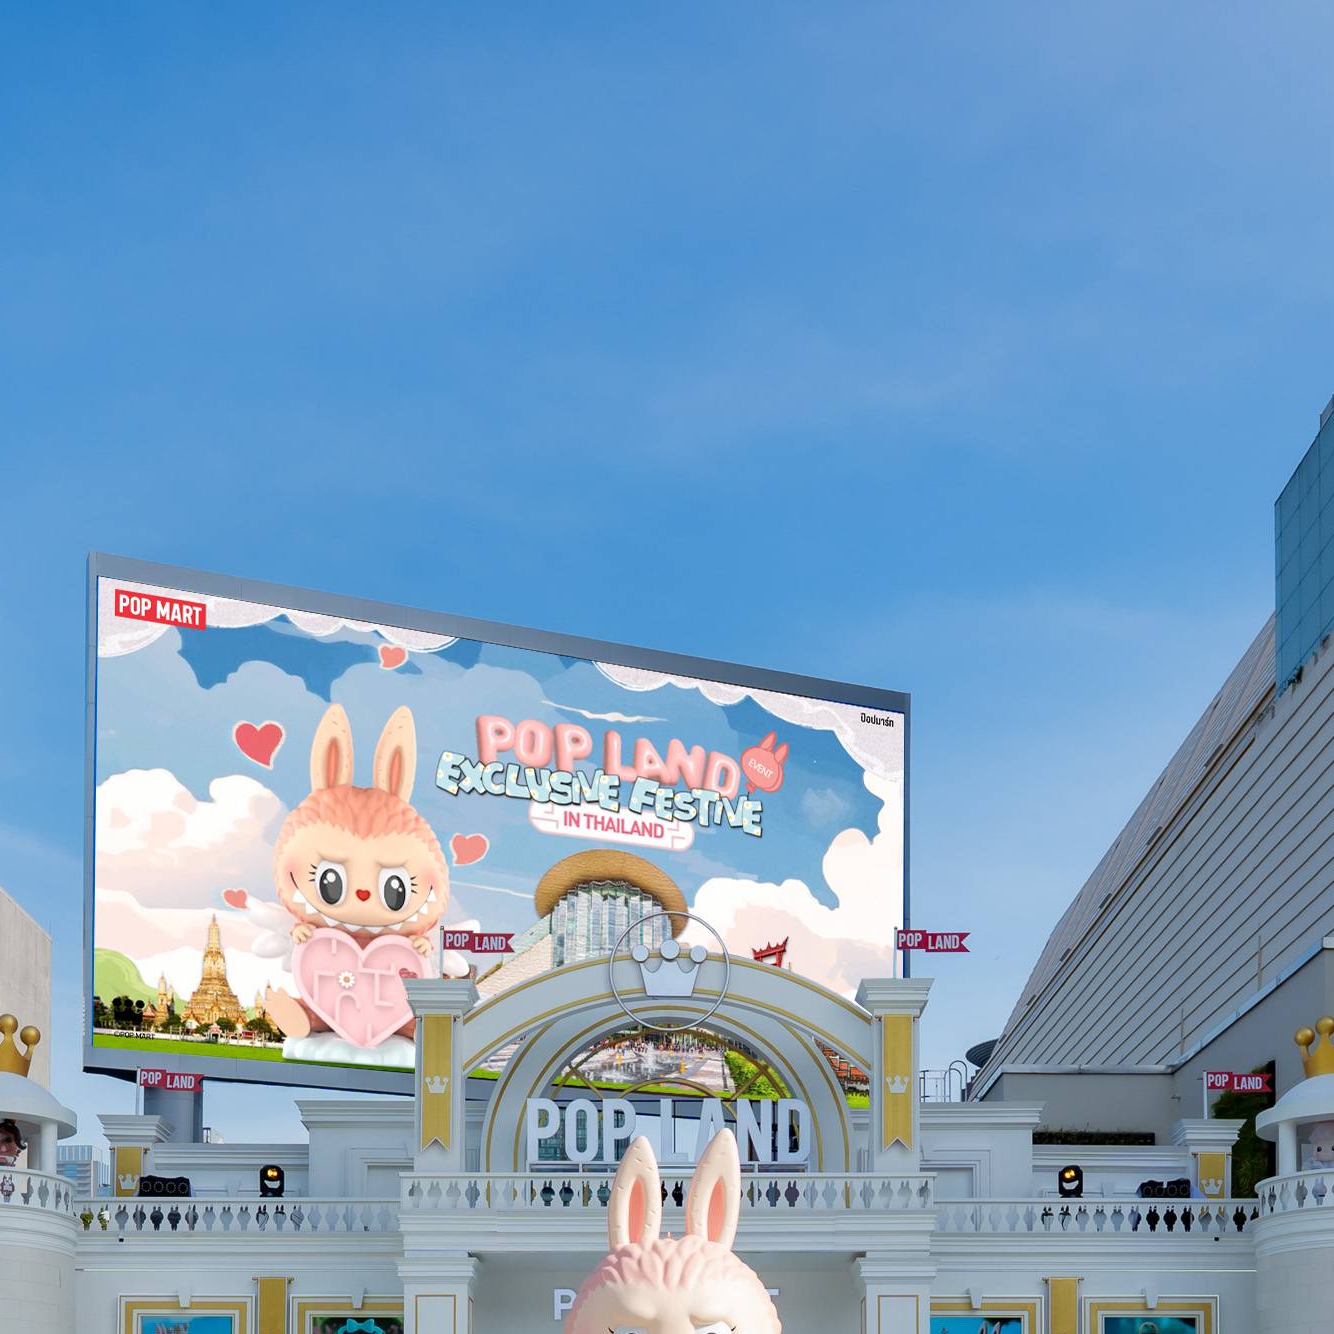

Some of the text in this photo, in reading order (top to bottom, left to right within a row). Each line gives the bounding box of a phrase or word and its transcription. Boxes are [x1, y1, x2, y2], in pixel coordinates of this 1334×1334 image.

[119, 594, 202, 626] POP MART
[475, 715, 741, 800] POP LAND
[748, 758, 773, 778] EVENT
[435, 751, 763, 837] EXCLUSIVE FESTIVE
[564, 811, 665, 840] IN THAILAND
[445, 933, 506, 950] POP LAND
[898, 932, 960, 950] POP LAND
[140, 1071, 195, 1089] POP LAND
[1208, 1073, 1263, 1090] POP LAND
[526, 1098, 636, 1161] POP
